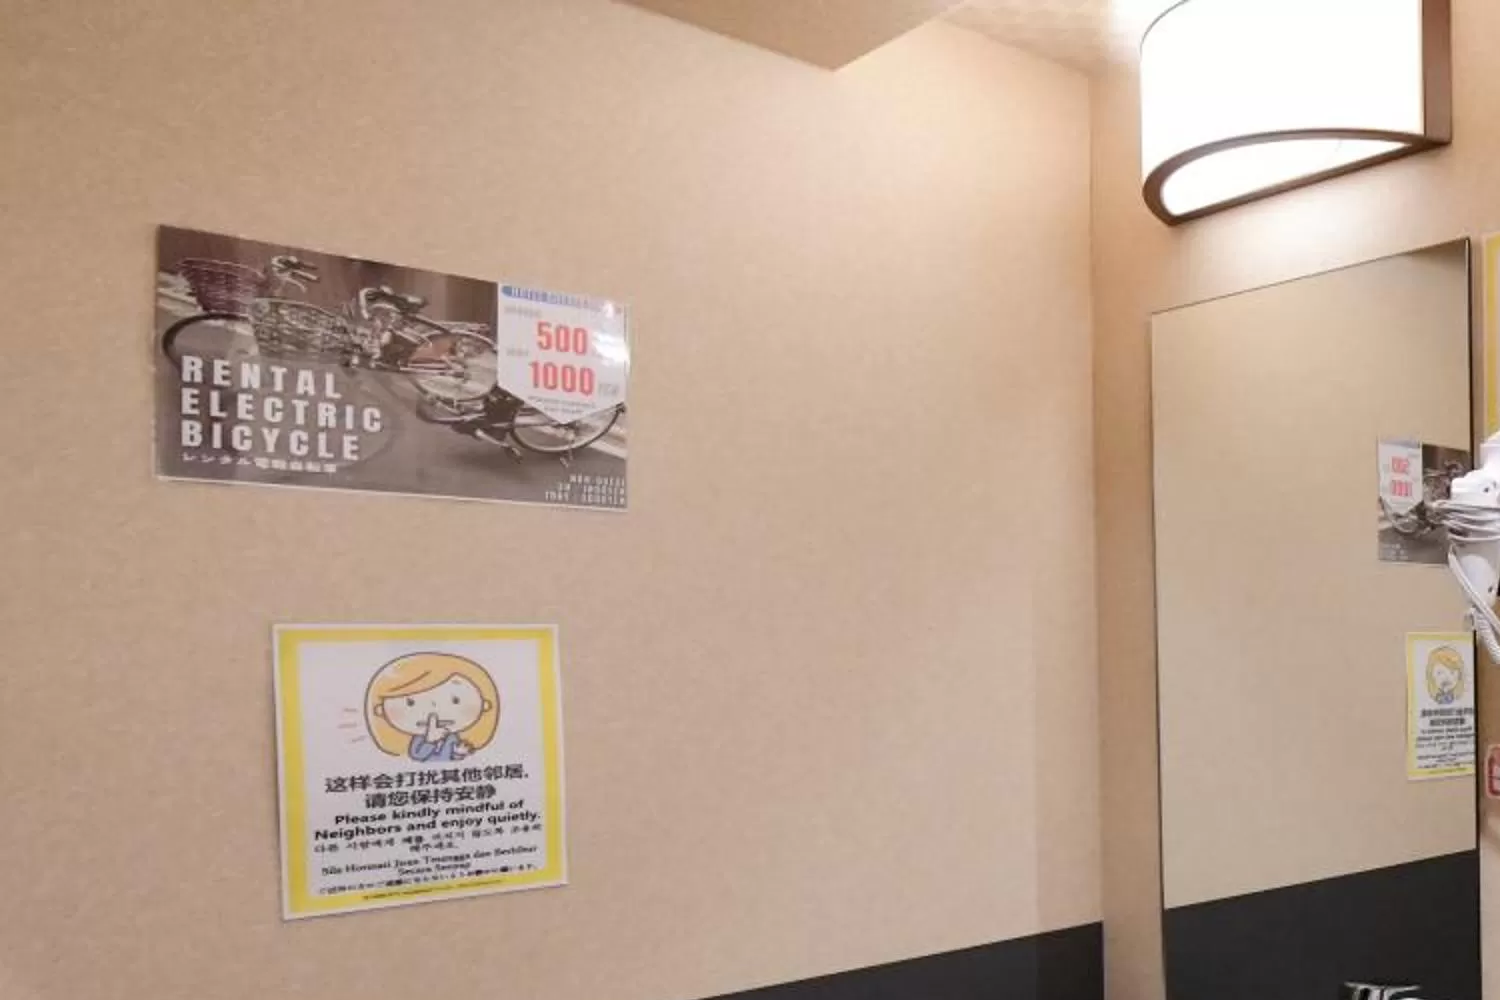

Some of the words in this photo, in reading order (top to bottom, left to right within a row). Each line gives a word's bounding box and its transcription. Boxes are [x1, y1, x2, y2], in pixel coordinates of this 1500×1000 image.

[537, 320, 588, 356] 500
[181, 355, 342, 400] RENTAL
[529, 360, 594, 397] 1000
[181, 387, 381, 433] ELECTRIC
[181, 419, 359, 461] BICYCLE
[315, 823, 402, 841] Neighbors
[407, 818, 437, 831] and
[441, 815, 483, 829] enjoy
[487, 809, 541, 826] quietly.
[335, 812, 387, 825] Please
[392, 806, 441, 821] kindly
[445, 800, 505, 815] mindful
[509, 799, 525, 810] of
